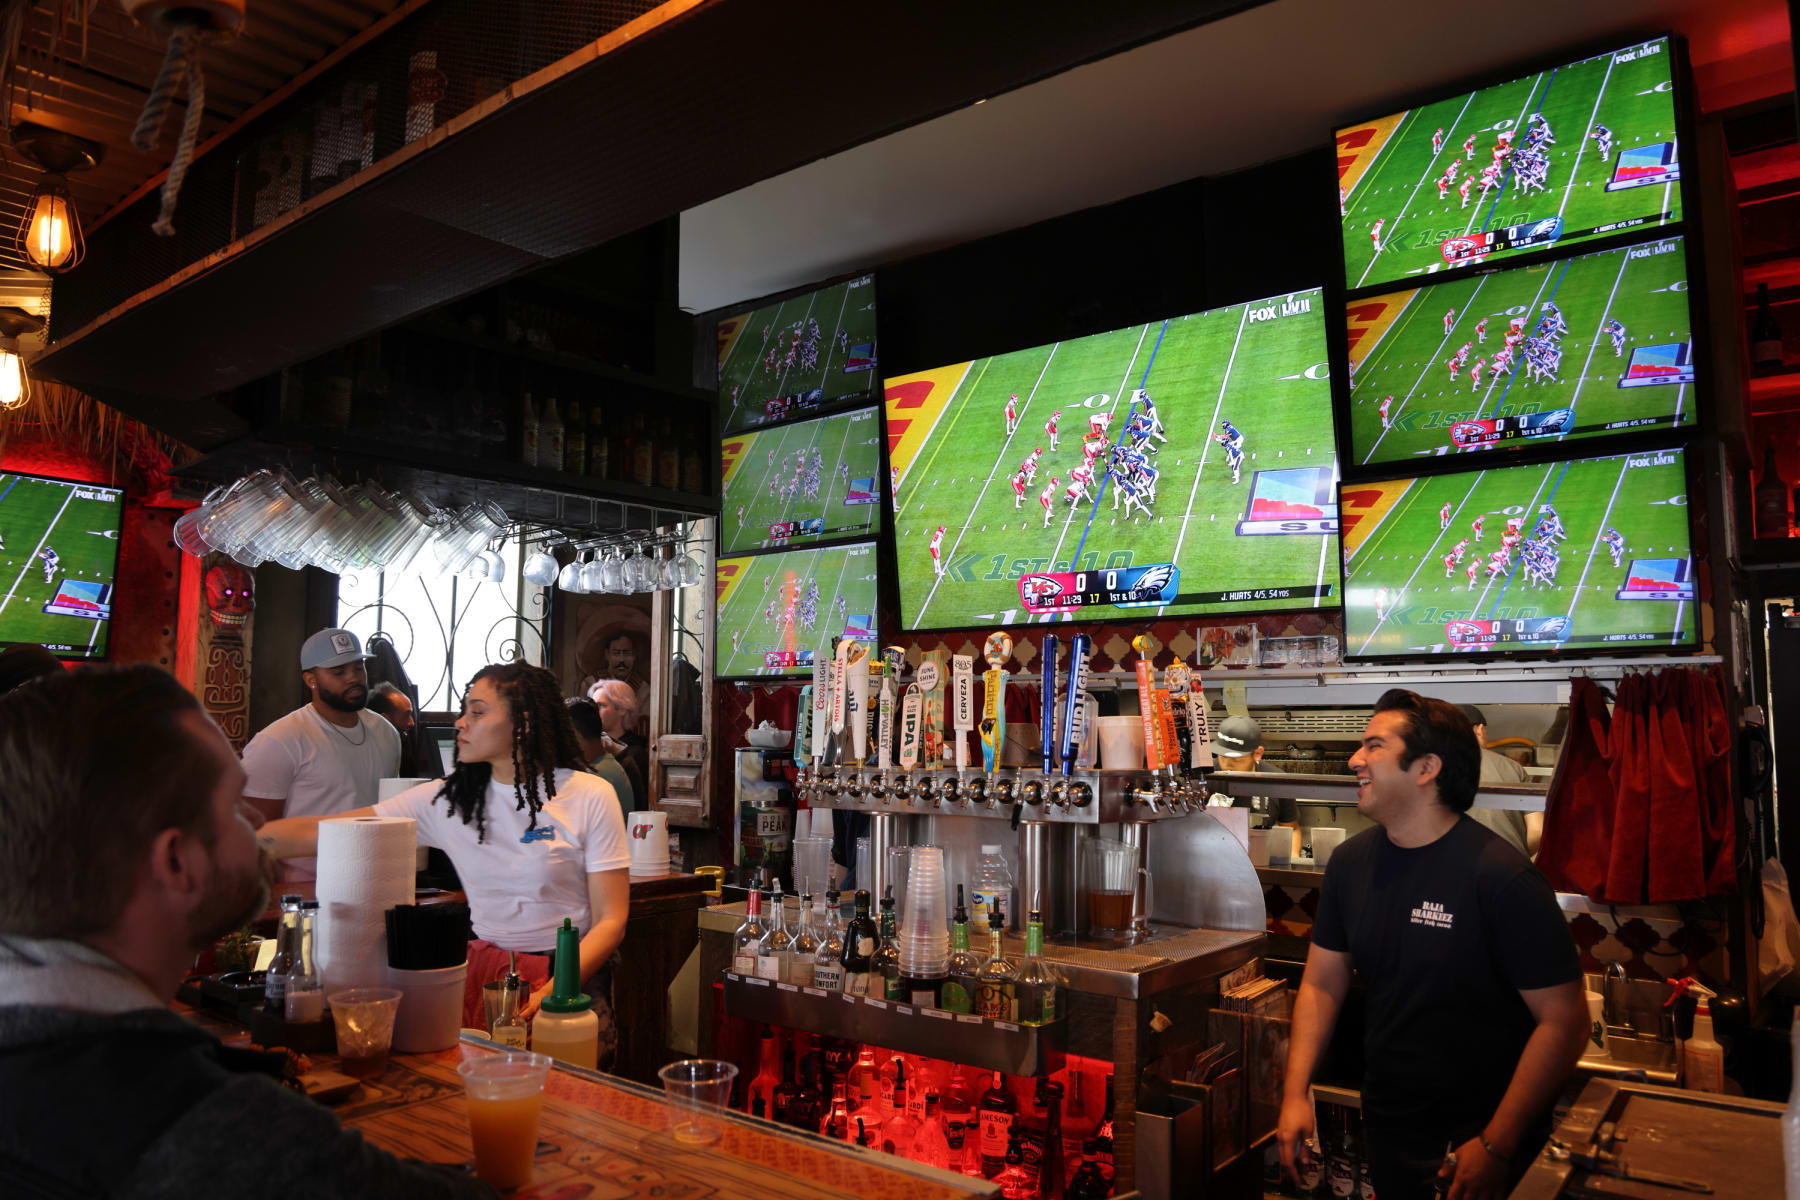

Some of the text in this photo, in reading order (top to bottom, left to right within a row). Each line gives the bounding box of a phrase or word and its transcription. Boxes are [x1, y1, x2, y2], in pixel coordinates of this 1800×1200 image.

[1616, 53, 1636, 64] FOX
[1631, 248, 1652, 260] FOX
[1249, 306, 1277, 323] FOX
[1630, 458, 1650, 468] FOX
[1075, 573, 1087, 593] 0
[1106, 571, 1117, 590] 0
[1044, 593, 1100, 606] 1ST 11:29 17
[1110, 590, 1136, 602] 1ST & 10
[1229, 591, 1252, 601] HURTS
[1269, 589, 1278, 599] 54
[919, 673, 936, 682] SHINE
[1070, 652, 1090, 744] BUD LIGHT
[1142, 699, 1152, 721] WHEAT
[904, 713, 916, 746] IPA
[1195, 702, 1208, 746] TRULY
[1144, 721, 1154, 745] MANGO
[1422, 901, 1444, 913] BAJA
[1411, 908, 1453, 923] SHARKEEZ
